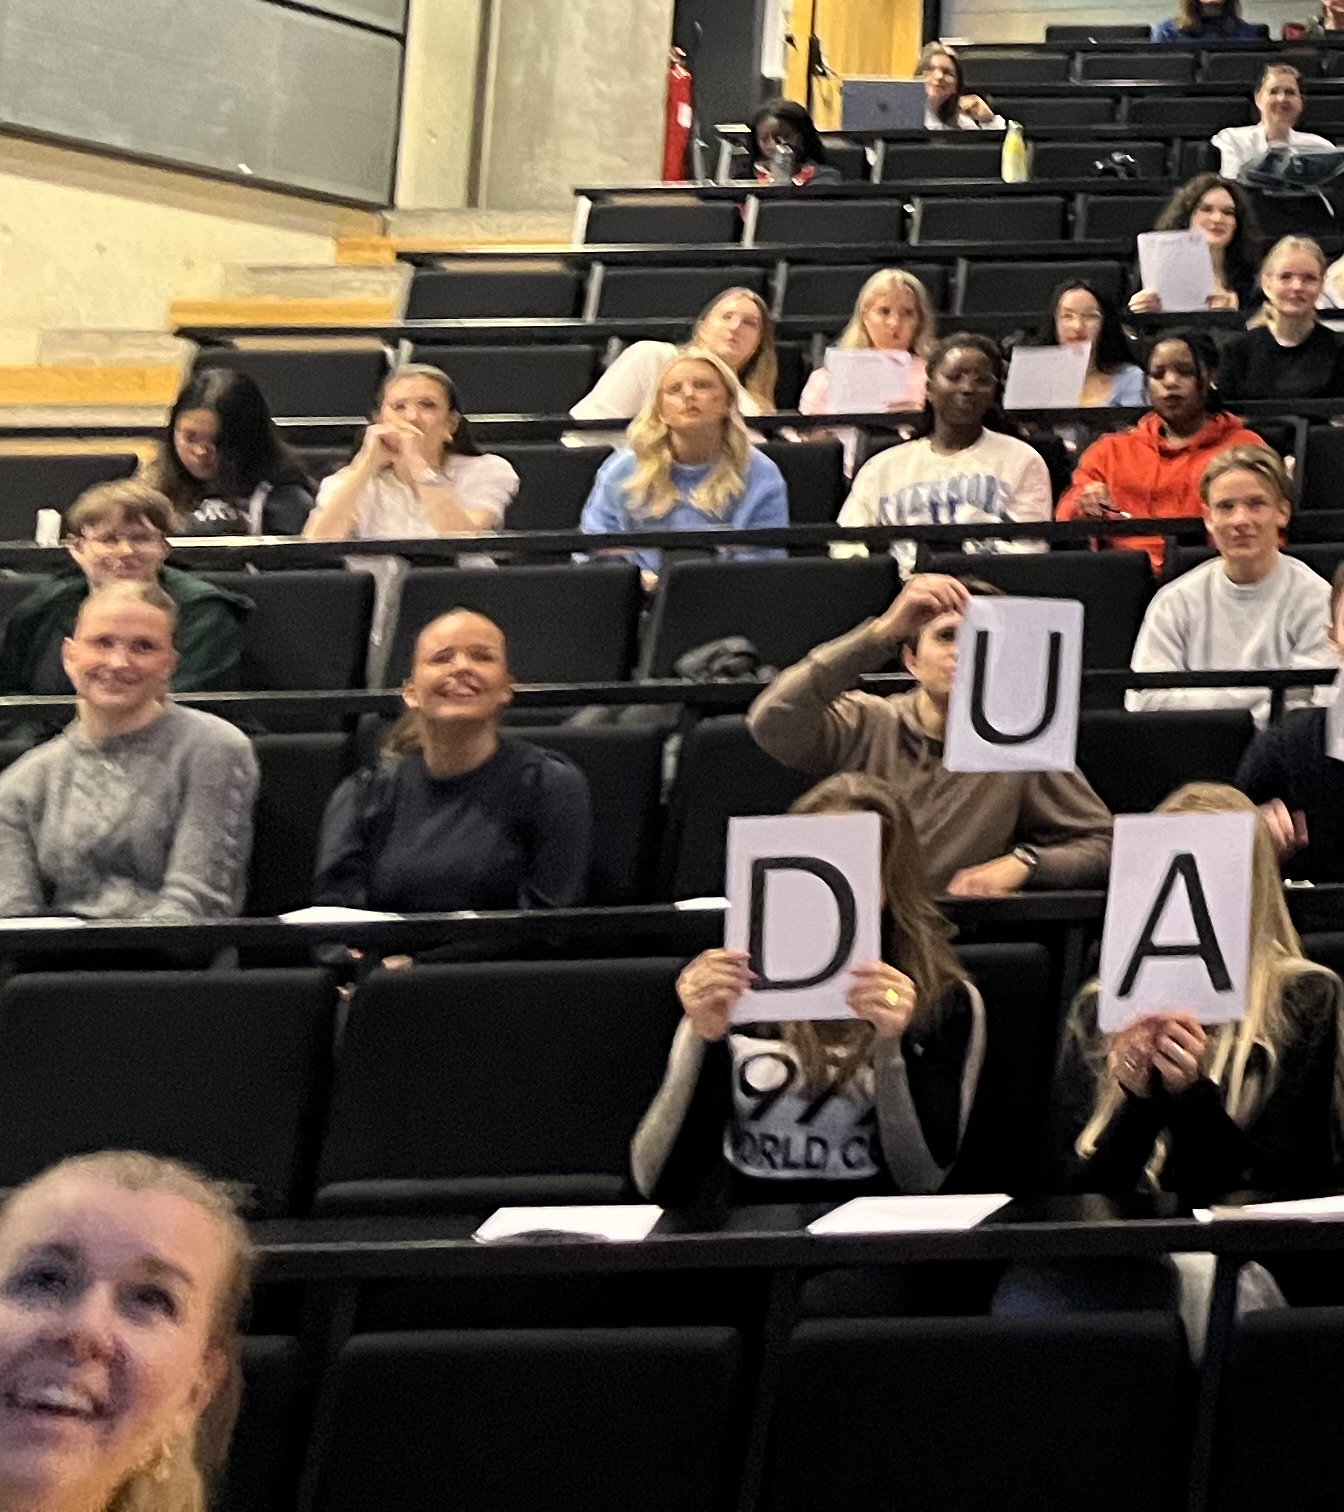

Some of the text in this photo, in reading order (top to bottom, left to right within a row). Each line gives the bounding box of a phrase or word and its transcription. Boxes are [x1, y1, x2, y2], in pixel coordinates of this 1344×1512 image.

[969, 630, 1065, 746] U
[748, 856, 858, 991] D
[1118, 852, 1235, 998] A
